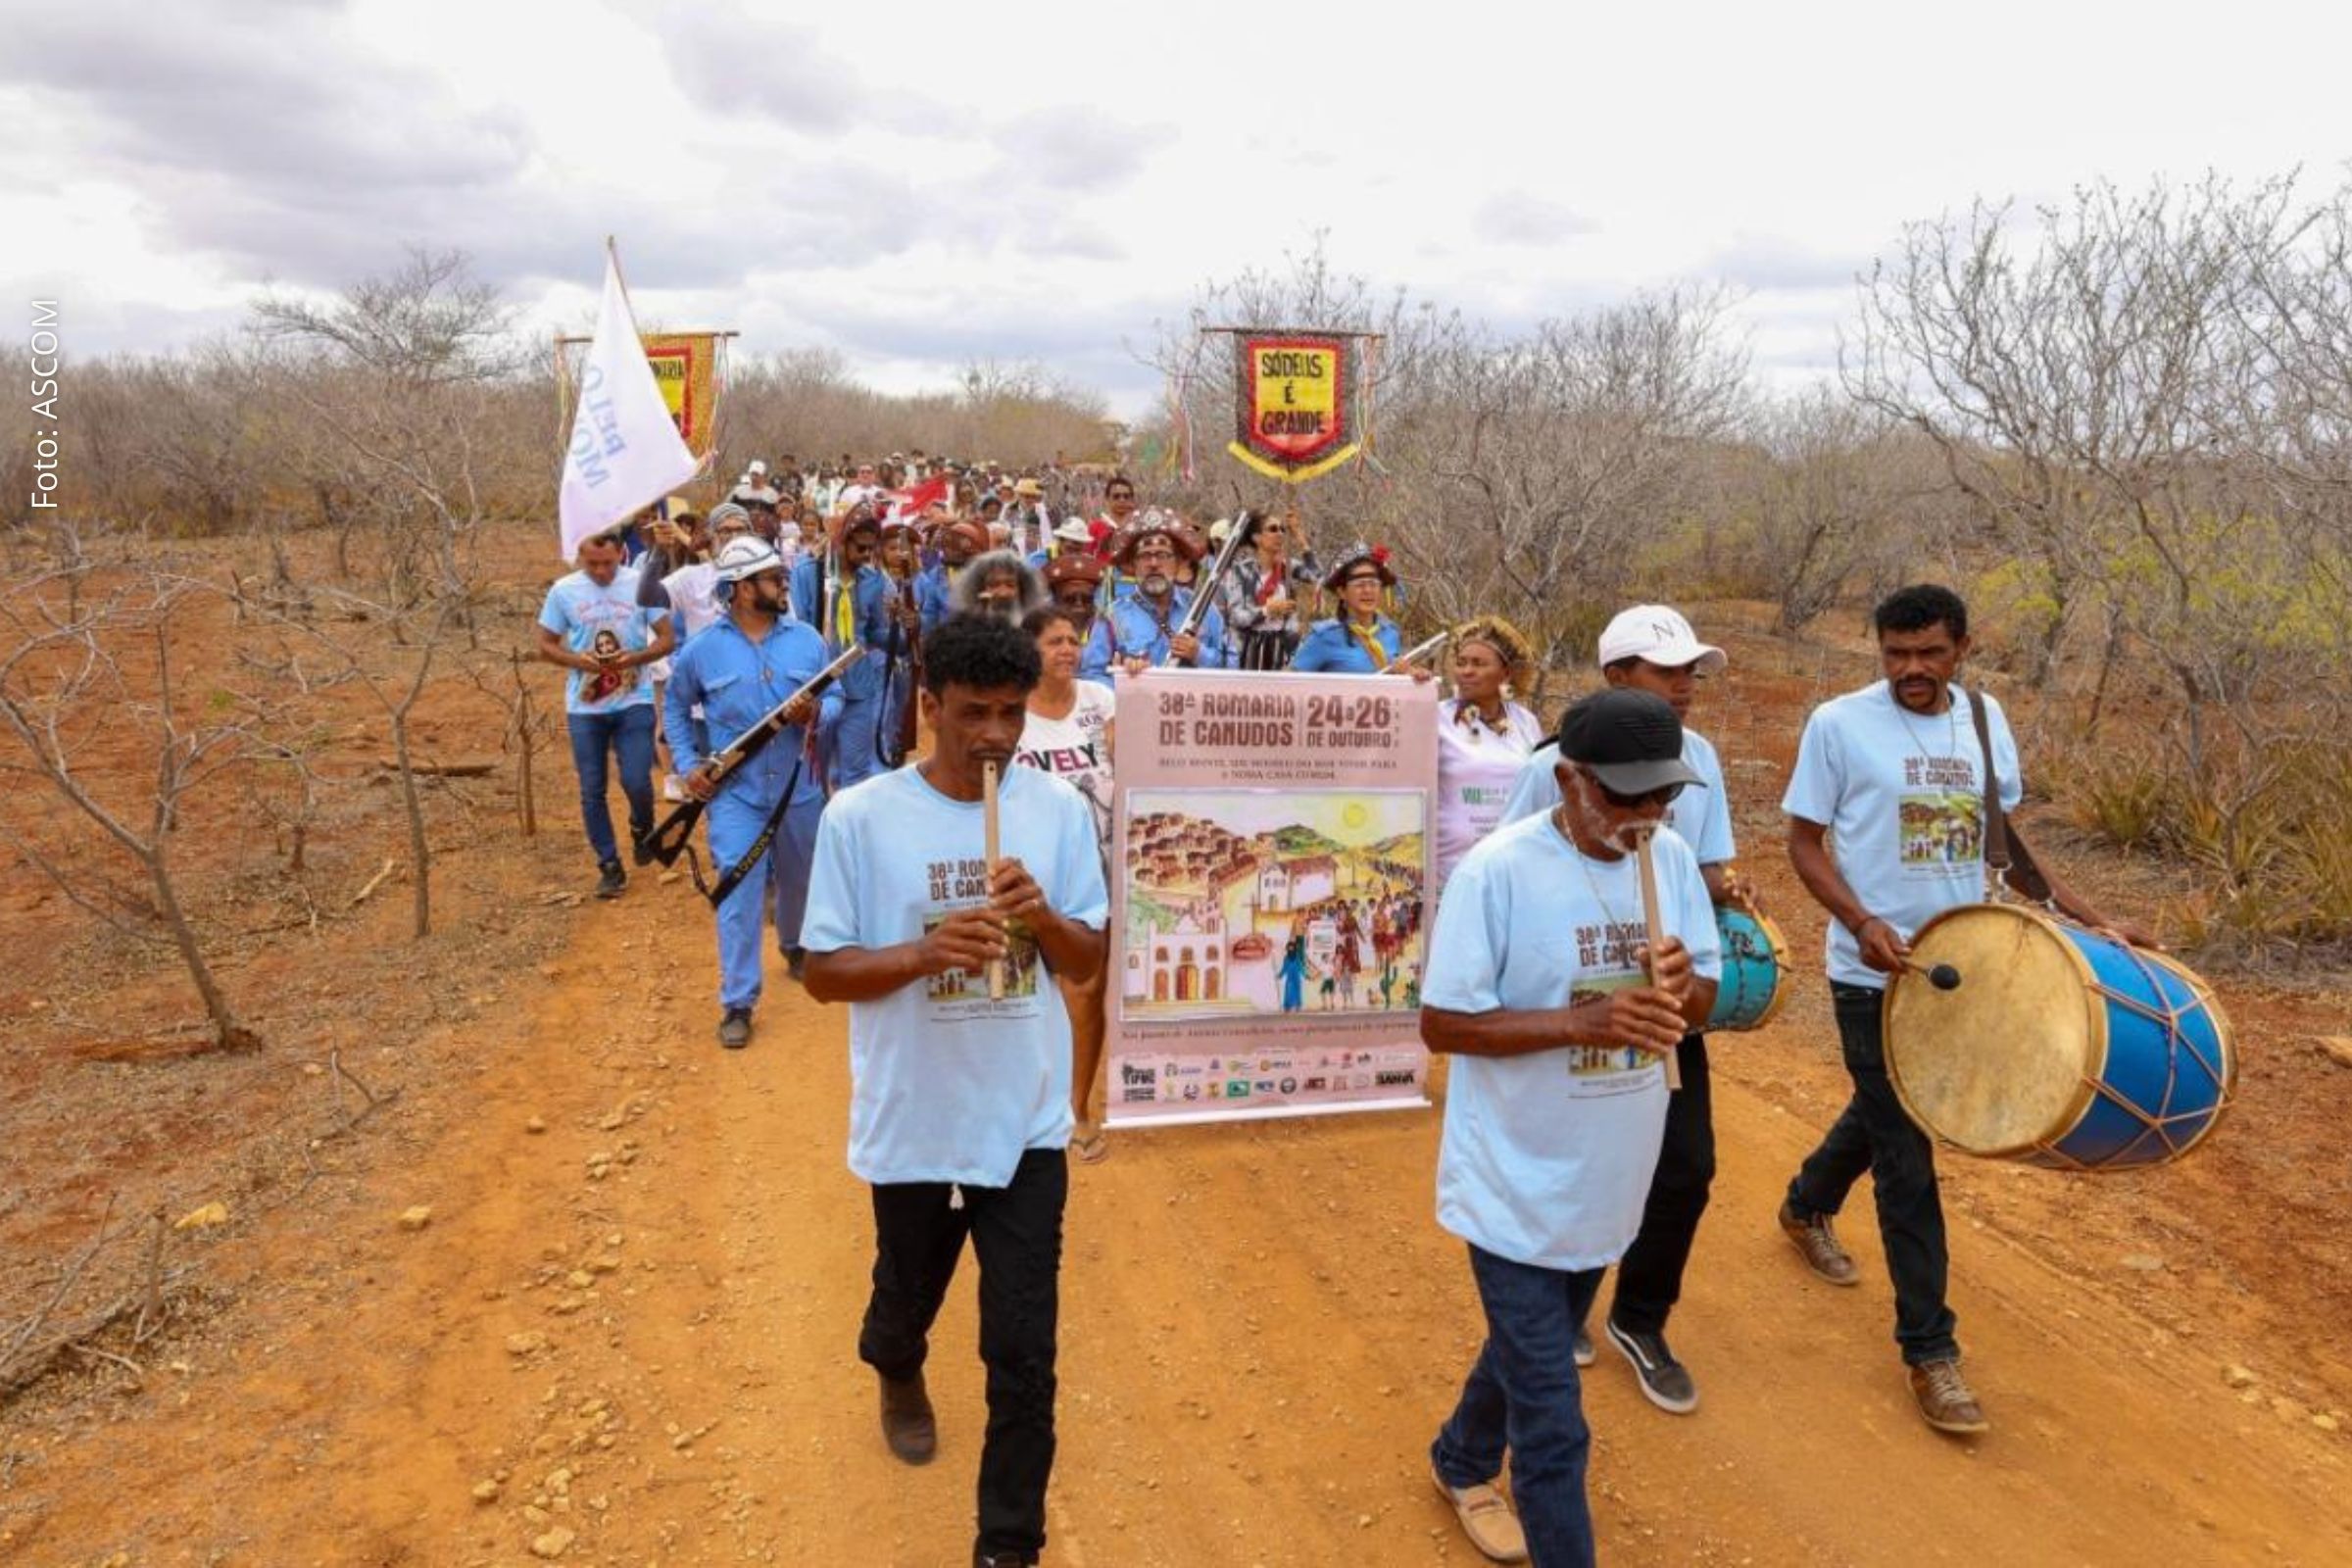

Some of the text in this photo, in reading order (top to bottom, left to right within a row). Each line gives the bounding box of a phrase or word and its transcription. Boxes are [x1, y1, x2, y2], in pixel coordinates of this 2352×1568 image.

[1285, 380, 1294, 404] É
[1261, 410, 1325, 434] GRANDE
[1201, 693, 1295, 718] ROMARIA
[1306, 695, 1343, 727] 24
[1355, 696, 1391, 729] 26
[1159, 720, 1294, 747] DE CANUDOS
[1306, 731, 1391, 748] DE OUTUBRO
[1017, 743, 1099, 772] OVELY
[930, 881, 951, 901] DE
[1580, 946, 1598, 967] DE
